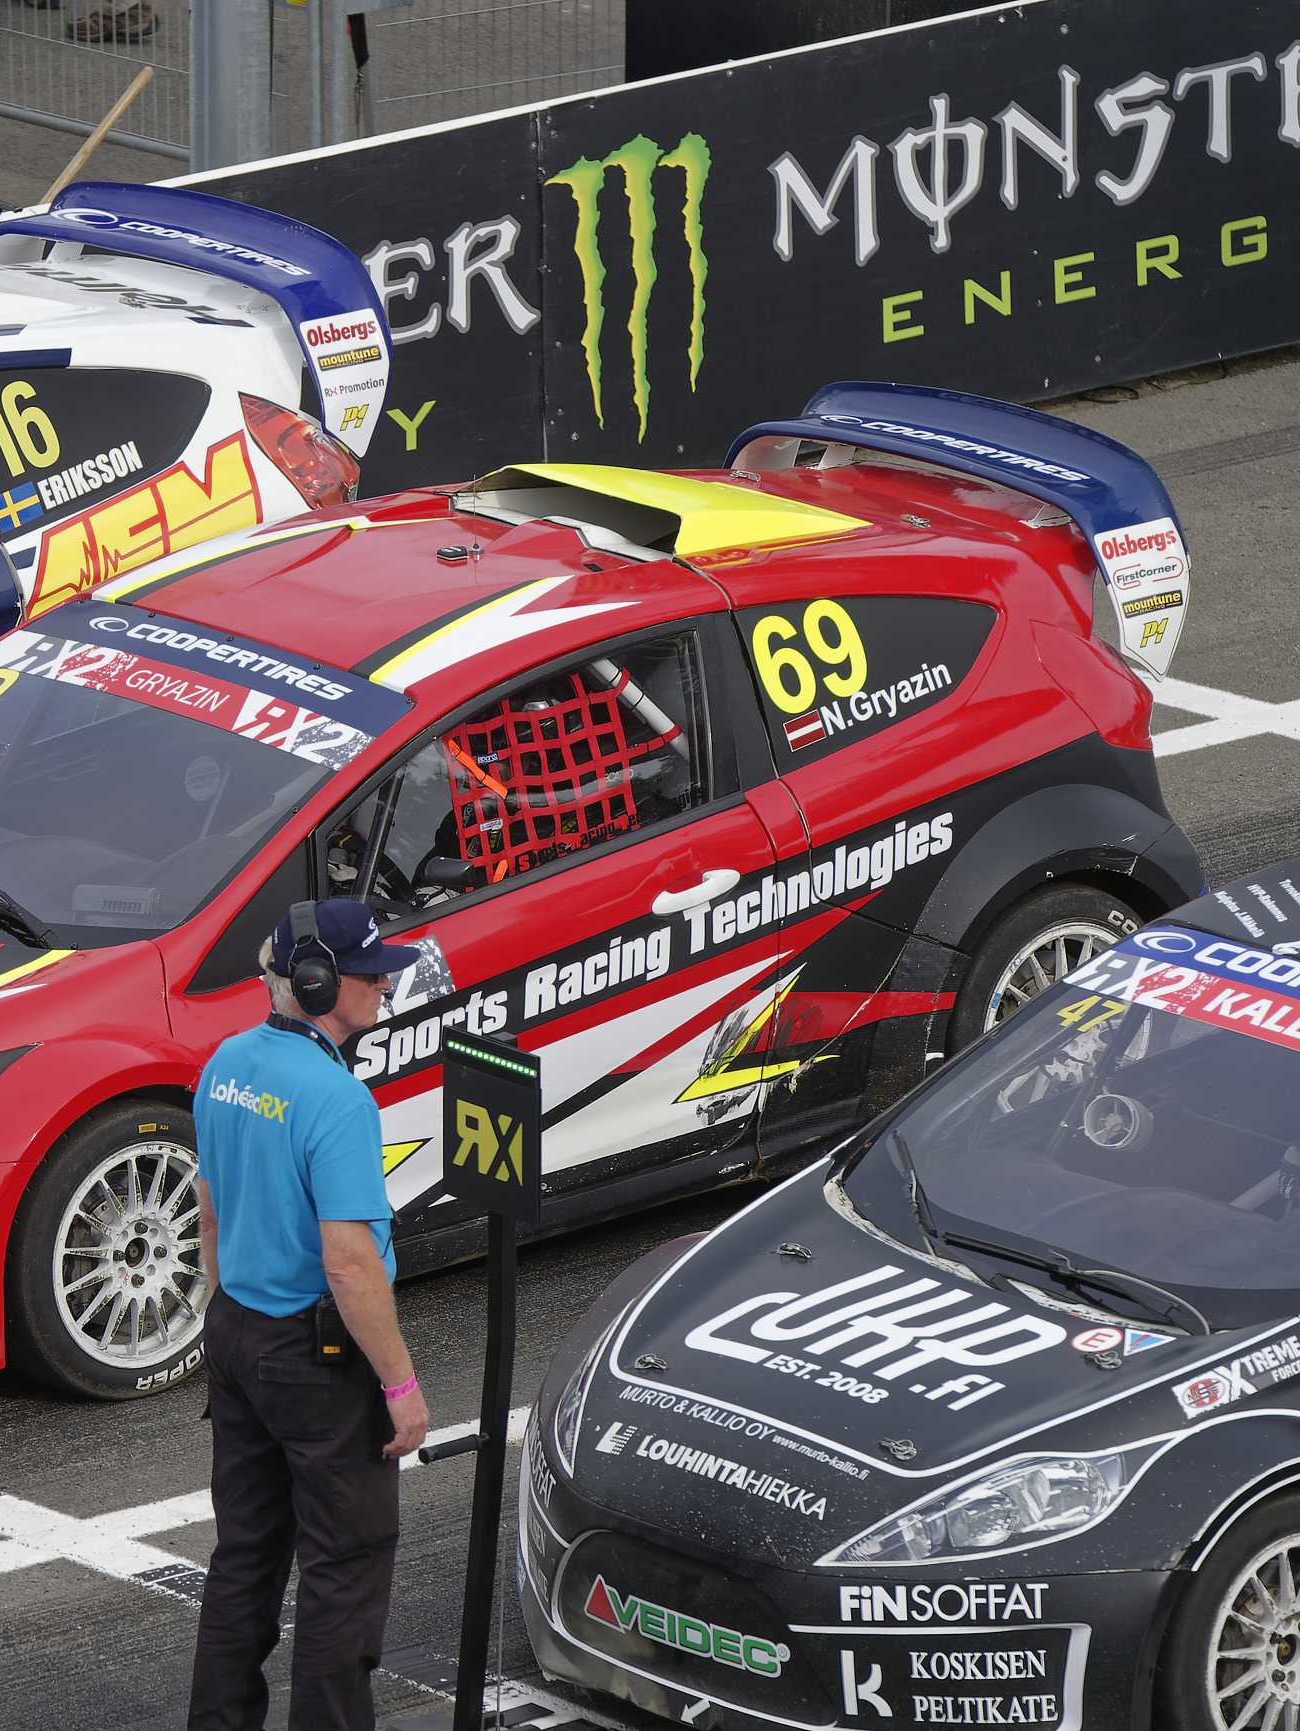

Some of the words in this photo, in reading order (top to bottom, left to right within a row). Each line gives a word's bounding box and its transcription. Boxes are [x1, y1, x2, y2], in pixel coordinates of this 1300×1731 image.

[120, 221, 313, 276] COOPERTIRES
[883, 215, 1268, 344] ENERG
[307, 320, 376, 347] Olsbergs
[320, 347, 380, 368] mountune
[339, 377, 385, 395] Promotion
[38, 440, 144, 511] ERIKSSON
[859, 420, 1091, 482] COOPERTIRES
[1101, 530, 1177, 560] Olsbergs
[1116, 563, 1178, 584] FirstCorner
[1124, 591, 1182, 615] mountune
[126, 623, 354, 701] COOPERTIRES
[751, 599, 868, 714] 69
[125, 667, 230, 713] GRYAZIN
[820, 661, 953, 737] N.Gryazin
[523, 925, 671, 1019] Racing
[680, 812, 954, 953] Technologies
[1056, 995, 1128, 1033] 47
[763, 1354, 812, 1380] EST.
[815, 1370, 890, 1405] 2008
[619, 1385, 674, 1411] MURTO
[673, 1399, 688, 1413] &
[688, 1402, 746, 1434] KALLIO
[745, 1416, 776, 1441] OY
[772, 1434, 870, 1481] www.murto-kallio.fi
[636, 1434, 829, 1522] LOUHINTAHIEKKA
[840, 1583, 1049, 1622] FiNSOFFAT
[609, 1590, 783, 1679] VEIDEC
[909, 1649, 1048, 1682] KOSKISEN
[913, 1694, 1060, 1725] PELTIKATE
